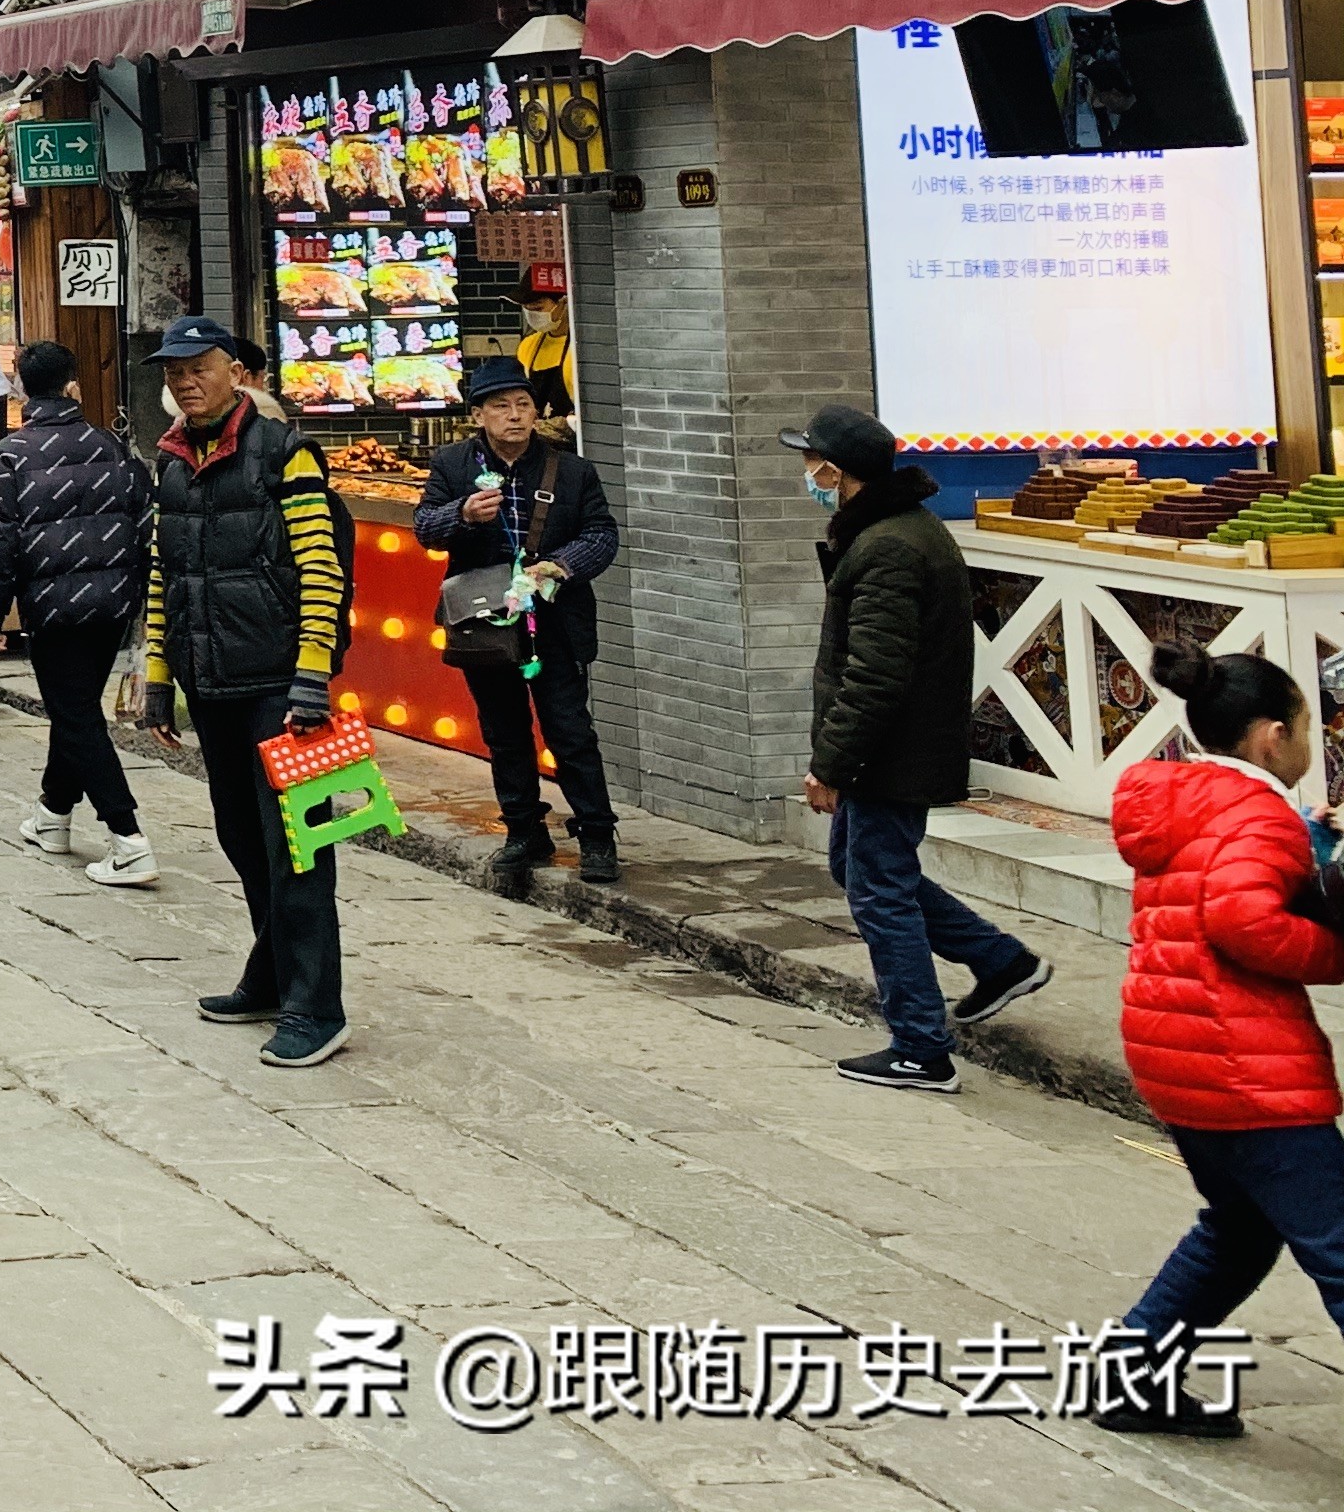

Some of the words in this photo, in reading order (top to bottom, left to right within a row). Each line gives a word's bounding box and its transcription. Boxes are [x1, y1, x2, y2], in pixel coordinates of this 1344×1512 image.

[27, 164, 95, 178] 紧急疏散出口
[961, 202, 1167, 223] 是我回忆中最悦耳的声音
[1058, 230, 1170, 250] 一次次的捶糖
[61, 243, 117, 299] 厕所
[907, 259, 1172, 280] 让手工酥糖变得更加可口和美味
